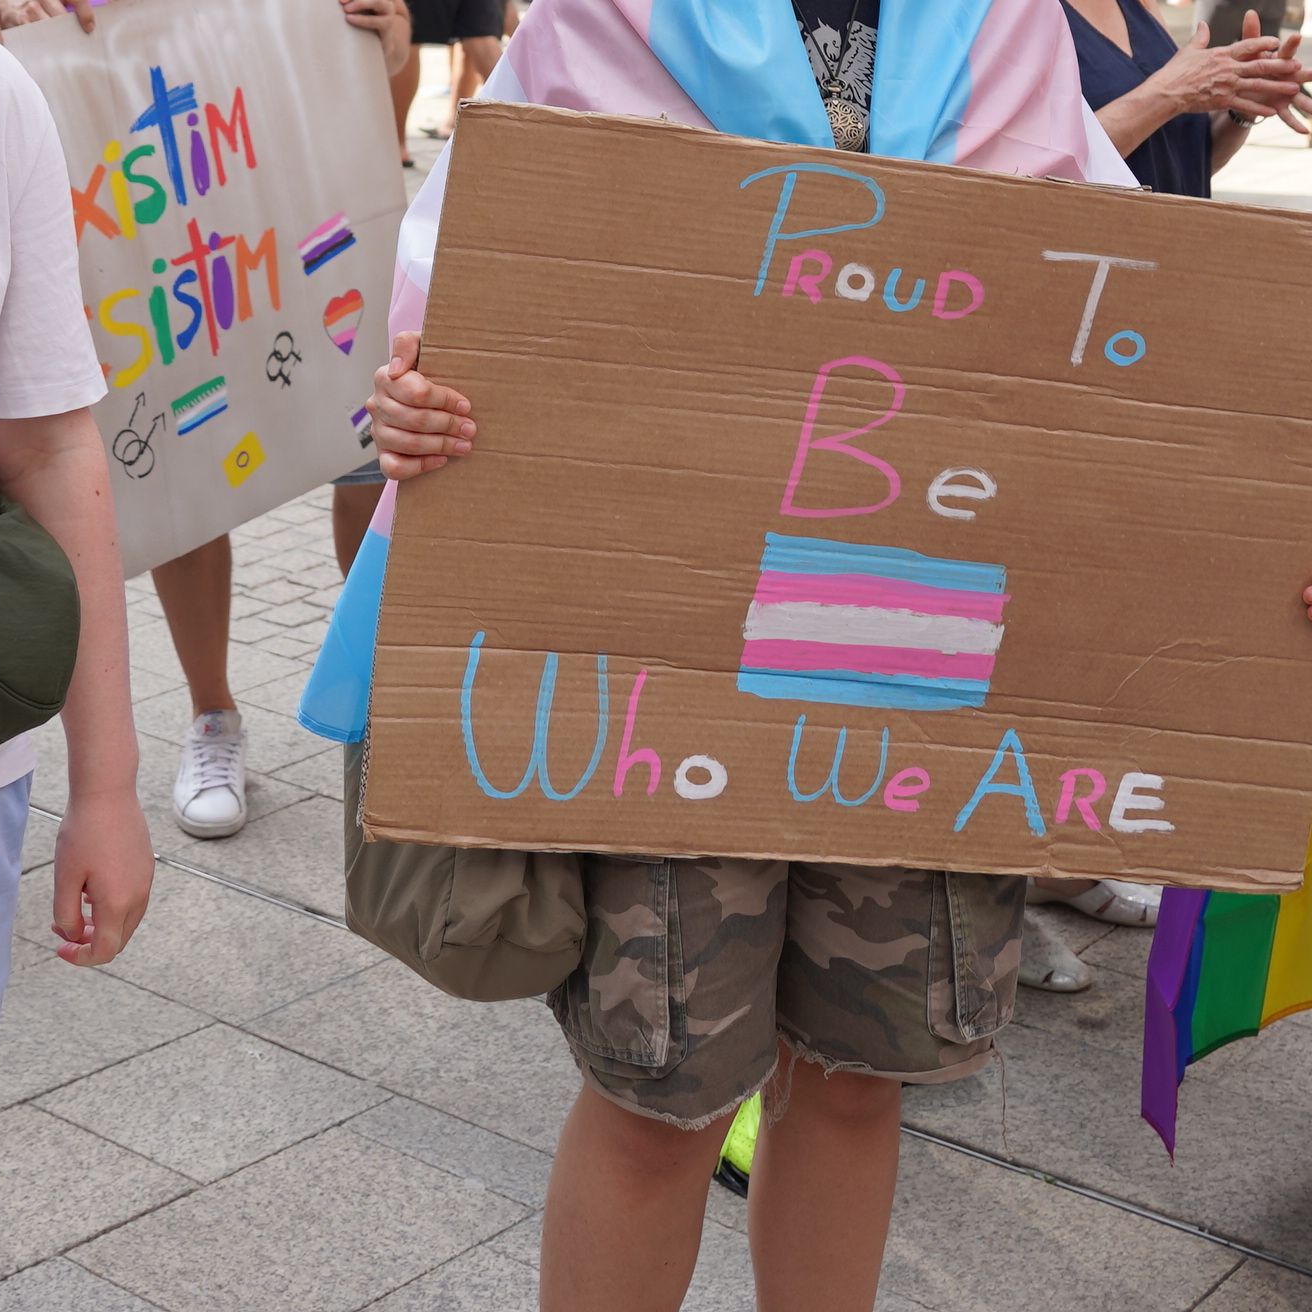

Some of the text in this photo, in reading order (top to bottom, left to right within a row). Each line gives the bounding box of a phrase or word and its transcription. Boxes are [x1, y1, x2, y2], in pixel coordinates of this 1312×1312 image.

[779, 354, 998, 521] Be
[461, 630, 1176, 838] Who We ARE
